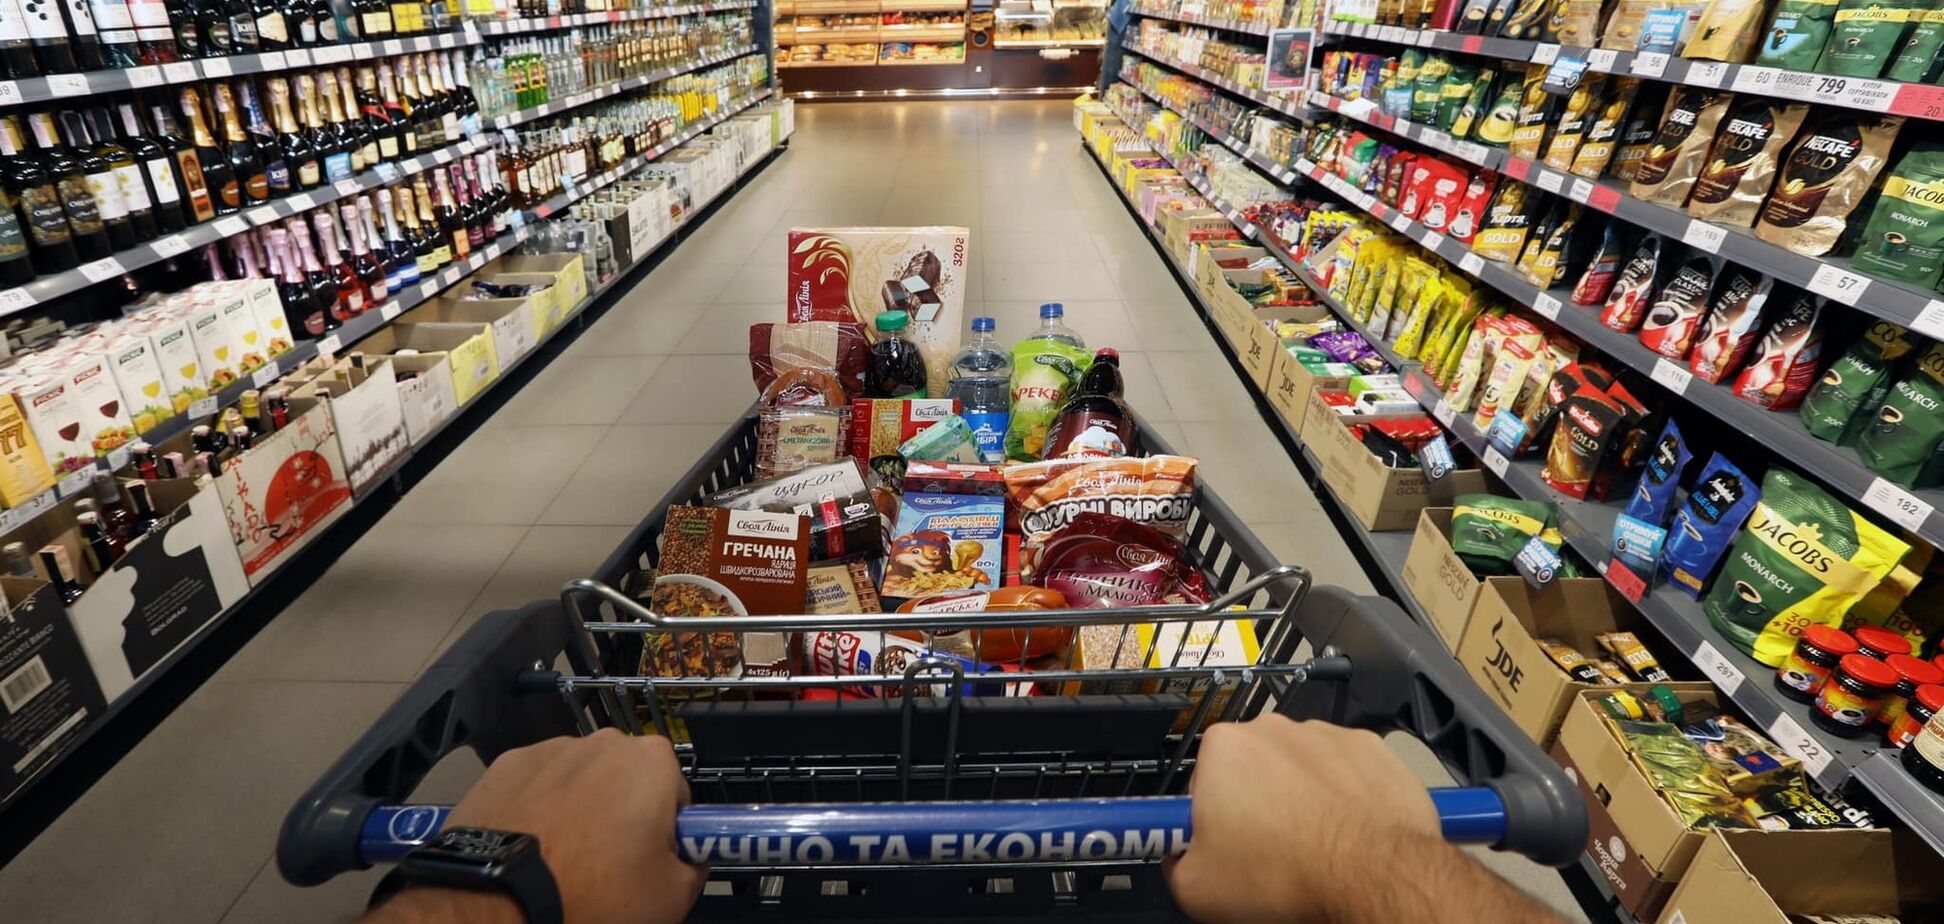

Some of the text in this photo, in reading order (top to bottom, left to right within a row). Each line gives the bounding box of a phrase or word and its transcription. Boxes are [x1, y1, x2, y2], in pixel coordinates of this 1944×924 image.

[1755, 71, 1771, 84] 60
[1776, 73, 1846, 94] ENRIQUE 799
[1924, 105, 1941, 118] 20
[1484, 233, 1521, 244] GOLD
[1837, 275, 1858, 291] 57
[1278, 372, 1295, 398] JDE
[1571, 426, 1599, 451] GOLD
[1897, 498, 1918, 516] 182
[737, 520, 791, 534] Своя Лінія
[723, 541, 797, 561] ГРЕЧАНА
[1754, 518, 1835, 574] JACOBS
[1740, 551, 1795, 595] MONARCH
[1485, 642, 1524, 693] JDE
[1716, 662, 1735, 679] 297
[1797, 738, 1821, 761] 22
[682, 835, 835, 864] УЧНО
[849, 833, 908, 862] ТА
[1594, 839, 1619, 870] Чорна
[1600, 858, 1627, 891] Карта
